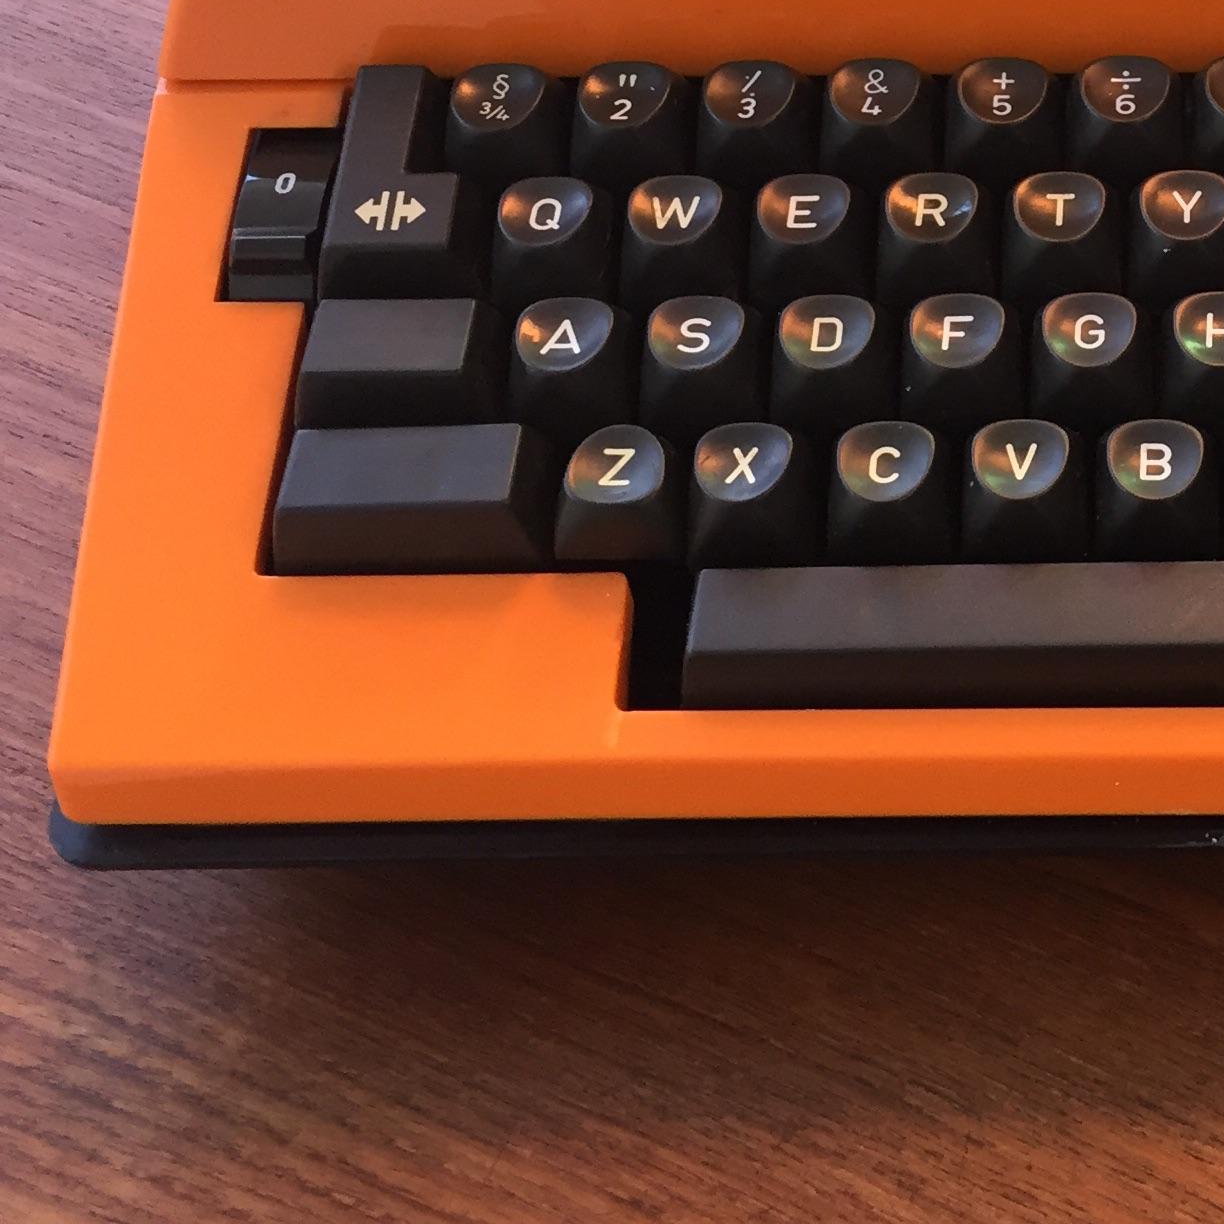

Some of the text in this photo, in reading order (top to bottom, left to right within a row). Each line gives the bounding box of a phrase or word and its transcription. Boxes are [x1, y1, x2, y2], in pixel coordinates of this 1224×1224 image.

[863, 68, 888, 94] &
[992, 71, 1015, 90] +
[610, 99, 633, 120] 2
[736, 97, 758, 119] 3
[861, 96, 883, 116] 4
[992, 95, 1013, 116] 5
[1115, 94, 1136, 115] 6
[274, 173, 296, 194] 0
[528, 197, 562, 231] Q
[652, 196, 700, 230] W
[785, 194, 820, 229] E
[914, 193, 946, 227] R
[1046, 193, 1075, 227] T
[1173, 190, 1202, 224] Y
[539, 319, 581, 355] A
[676, 317, 712, 353] S
[809, 317, 843, 352] D
[941, 315, 974, 350] F
[1074, 314, 1106, 350] G
[598, 448, 636, 486] Z
[724, 446, 759, 485] X
[868, 446, 902, 484] C
[1005, 443, 1038, 481] V
[1139, 443, 1173, 481] B
